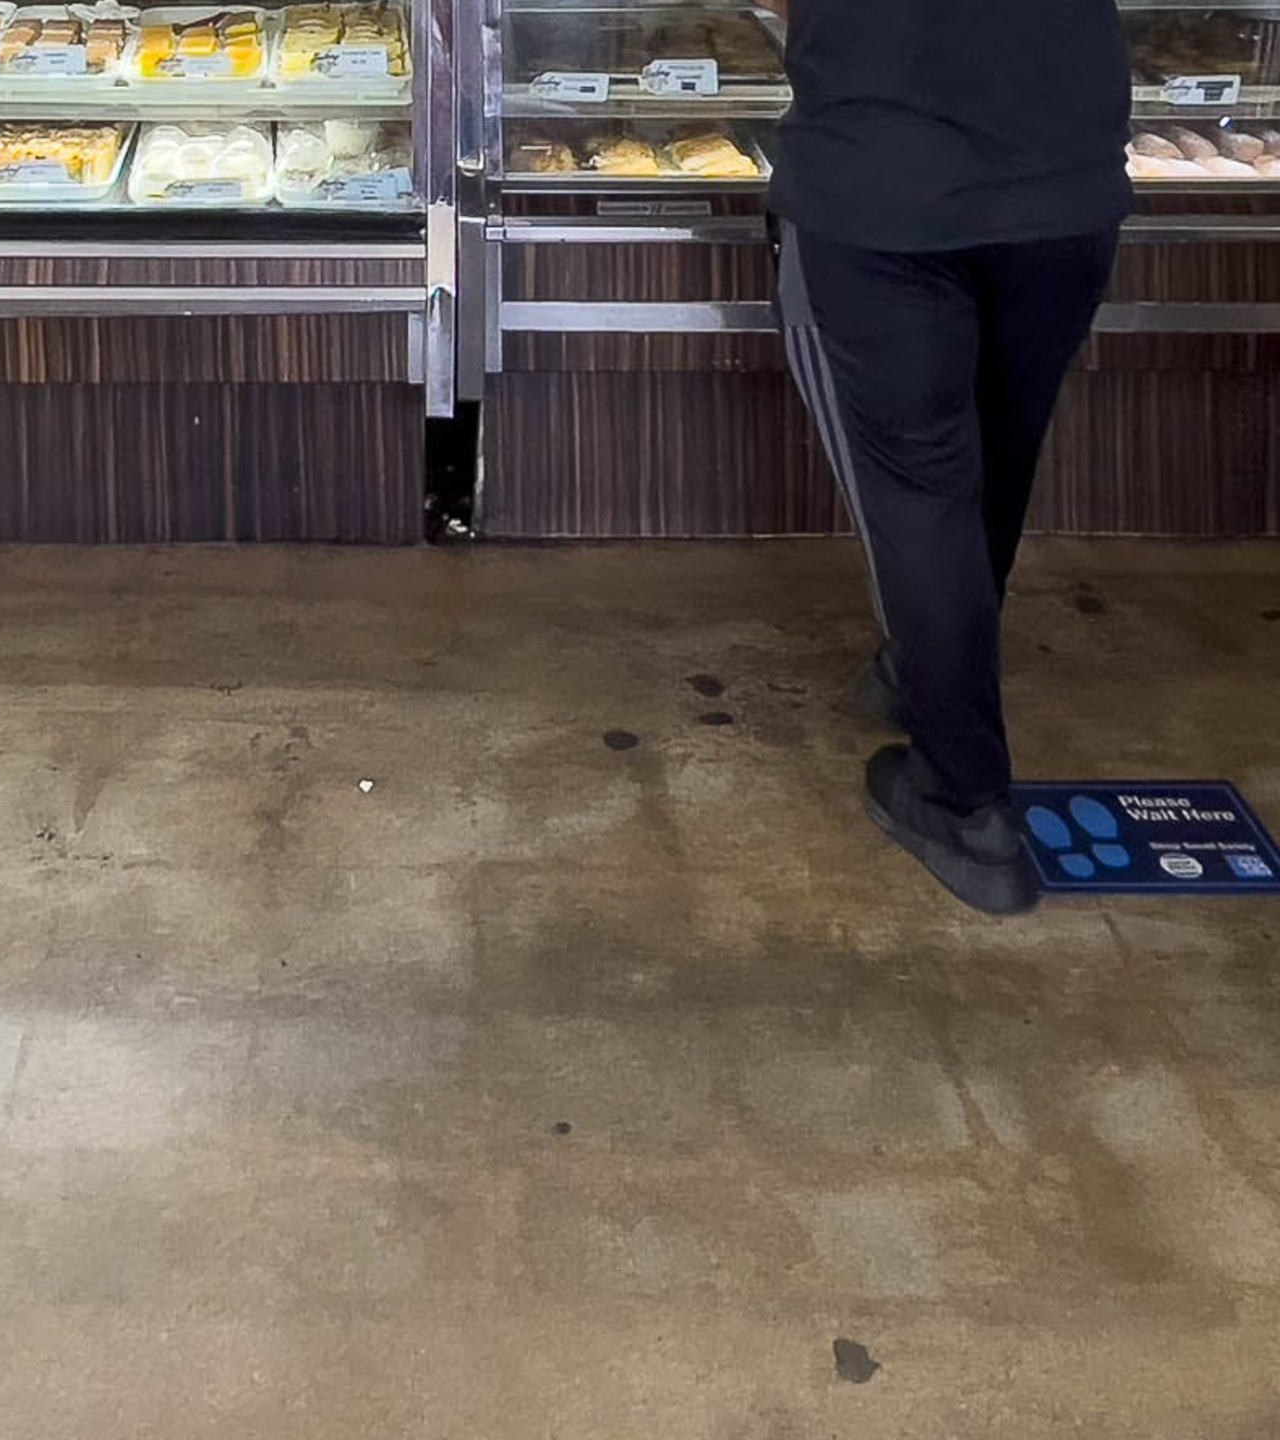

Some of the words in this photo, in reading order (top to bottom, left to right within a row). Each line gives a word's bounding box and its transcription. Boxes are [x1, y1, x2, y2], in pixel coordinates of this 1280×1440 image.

[1118, 795, 1191, 808] Please
[1126, 809, 1179, 821] Wait
[1183, 809, 1236, 822] Here
